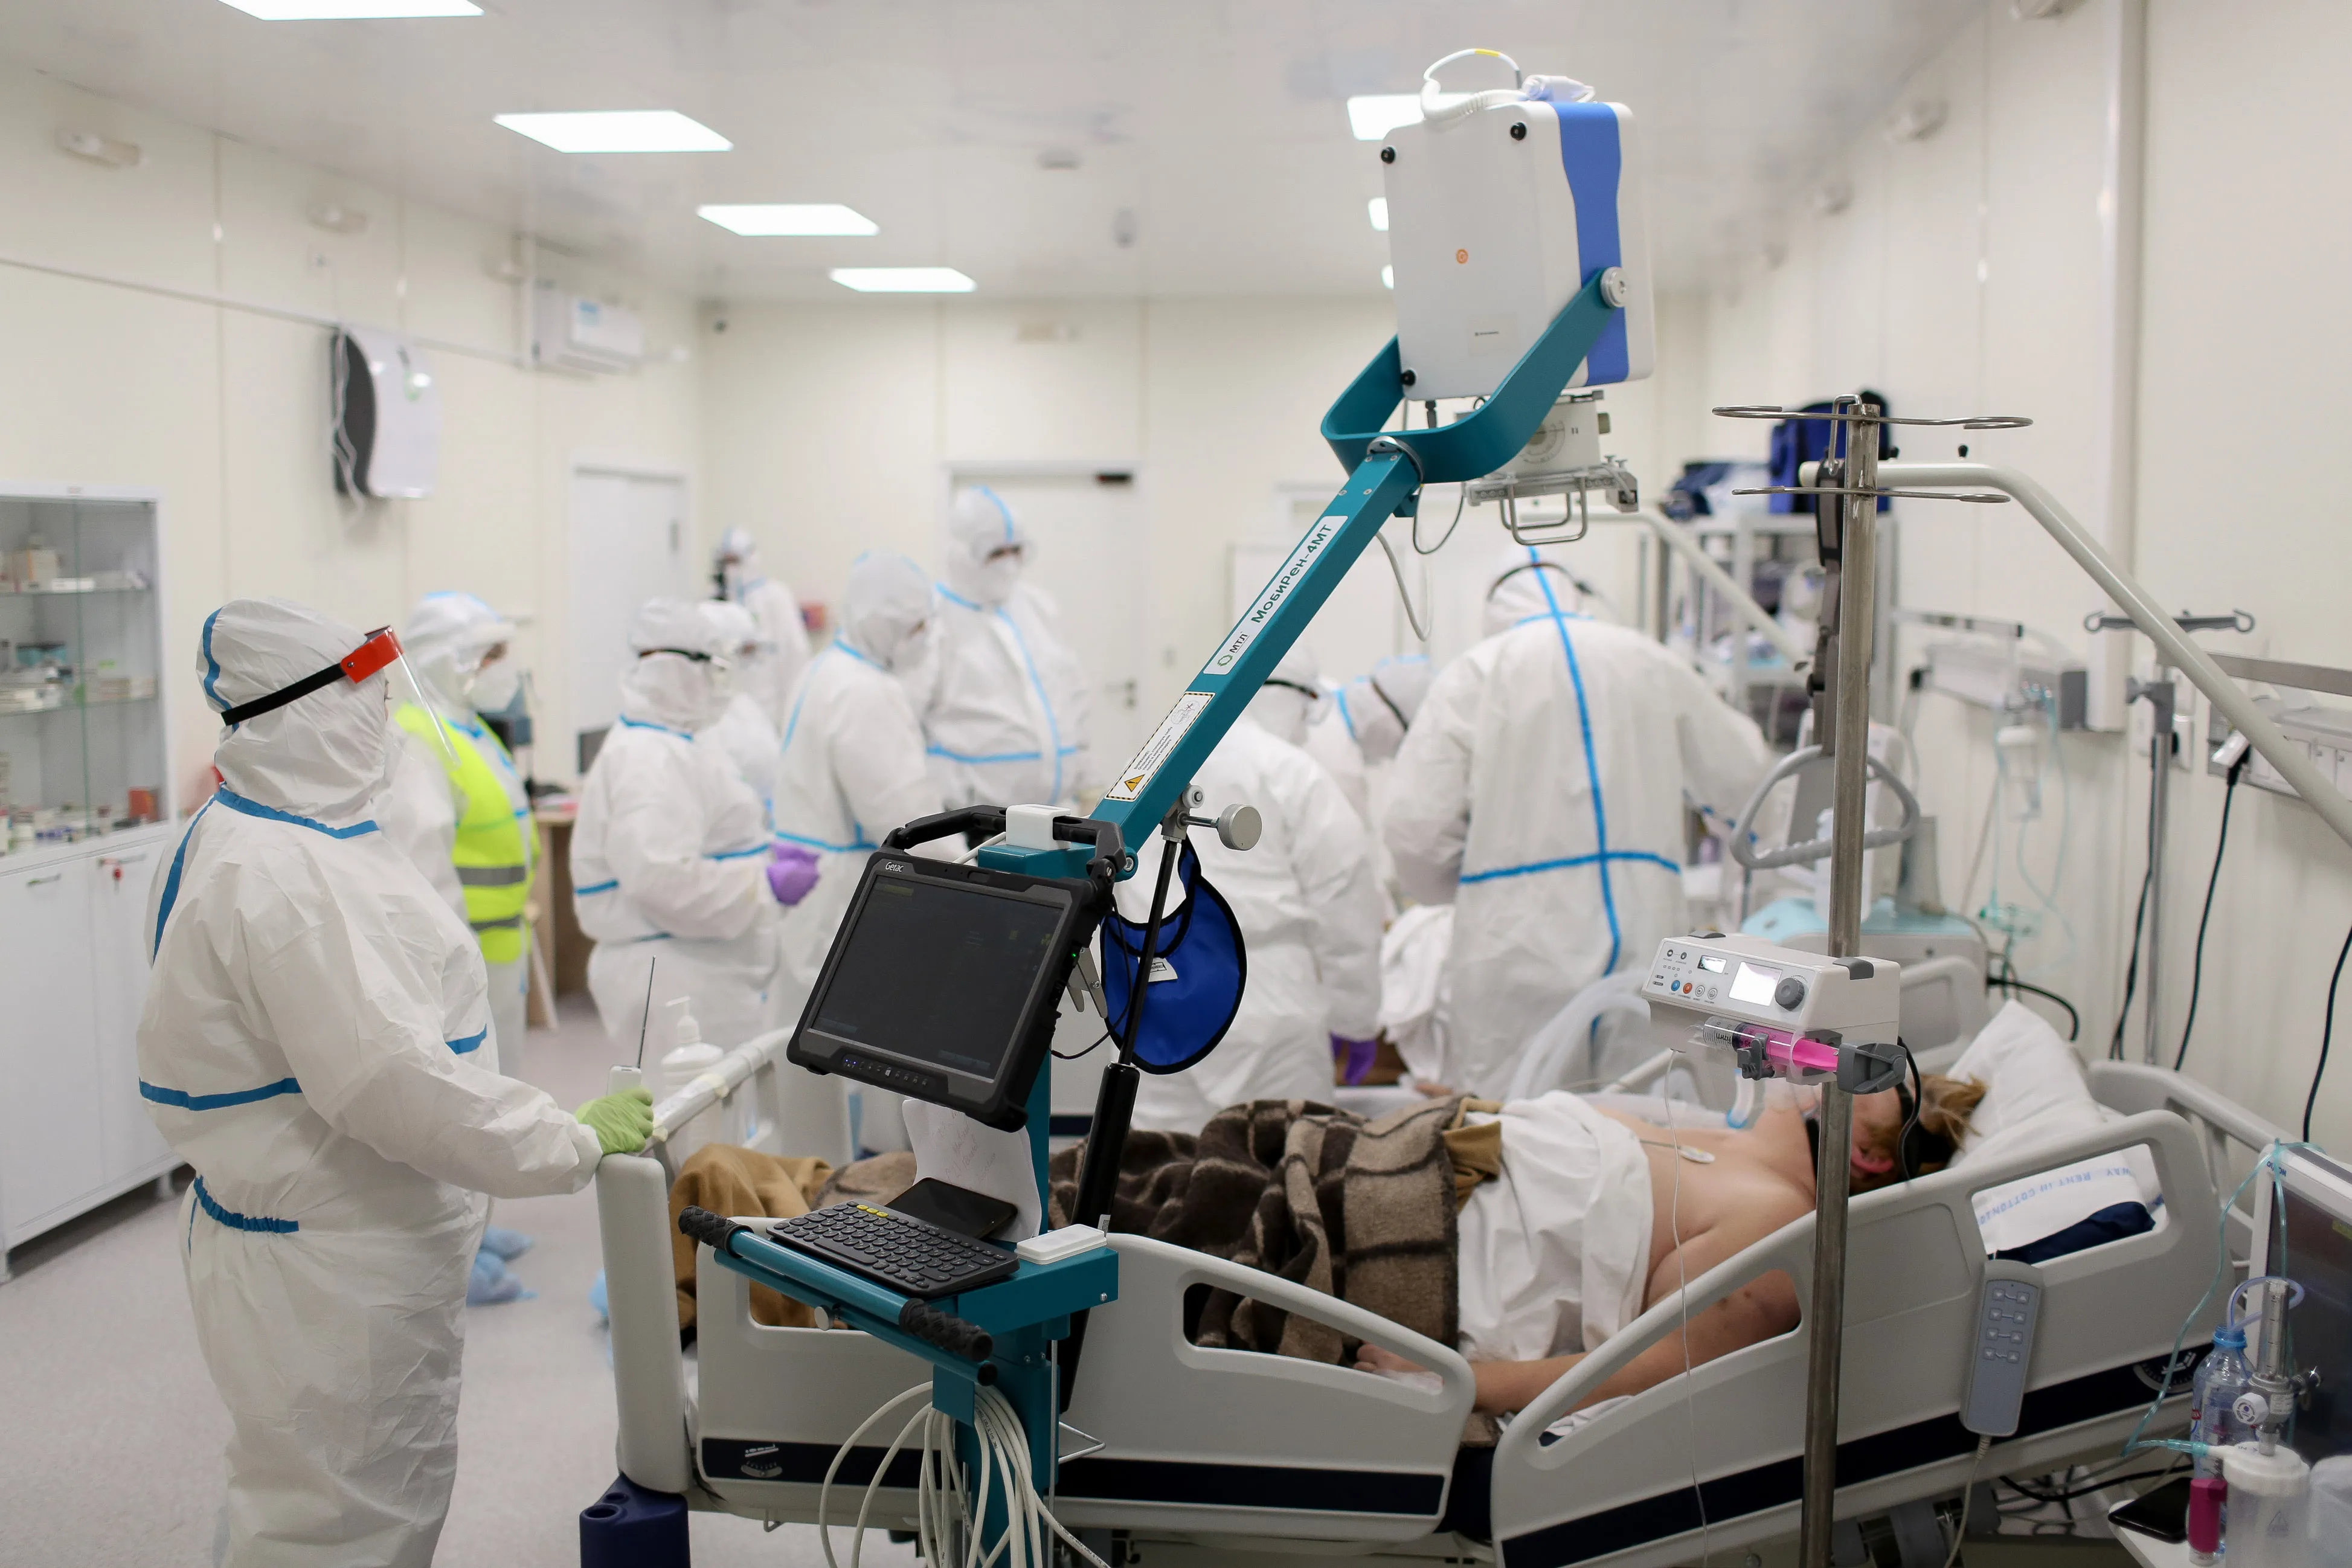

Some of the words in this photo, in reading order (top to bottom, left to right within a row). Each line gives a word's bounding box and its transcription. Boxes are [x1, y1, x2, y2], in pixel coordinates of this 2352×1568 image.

[1229, 632, 1248, 654] МТЛ
[1251, 524, 1332, 624] МобиРен-4МТ
[885, 861, 904, 872] Getac
